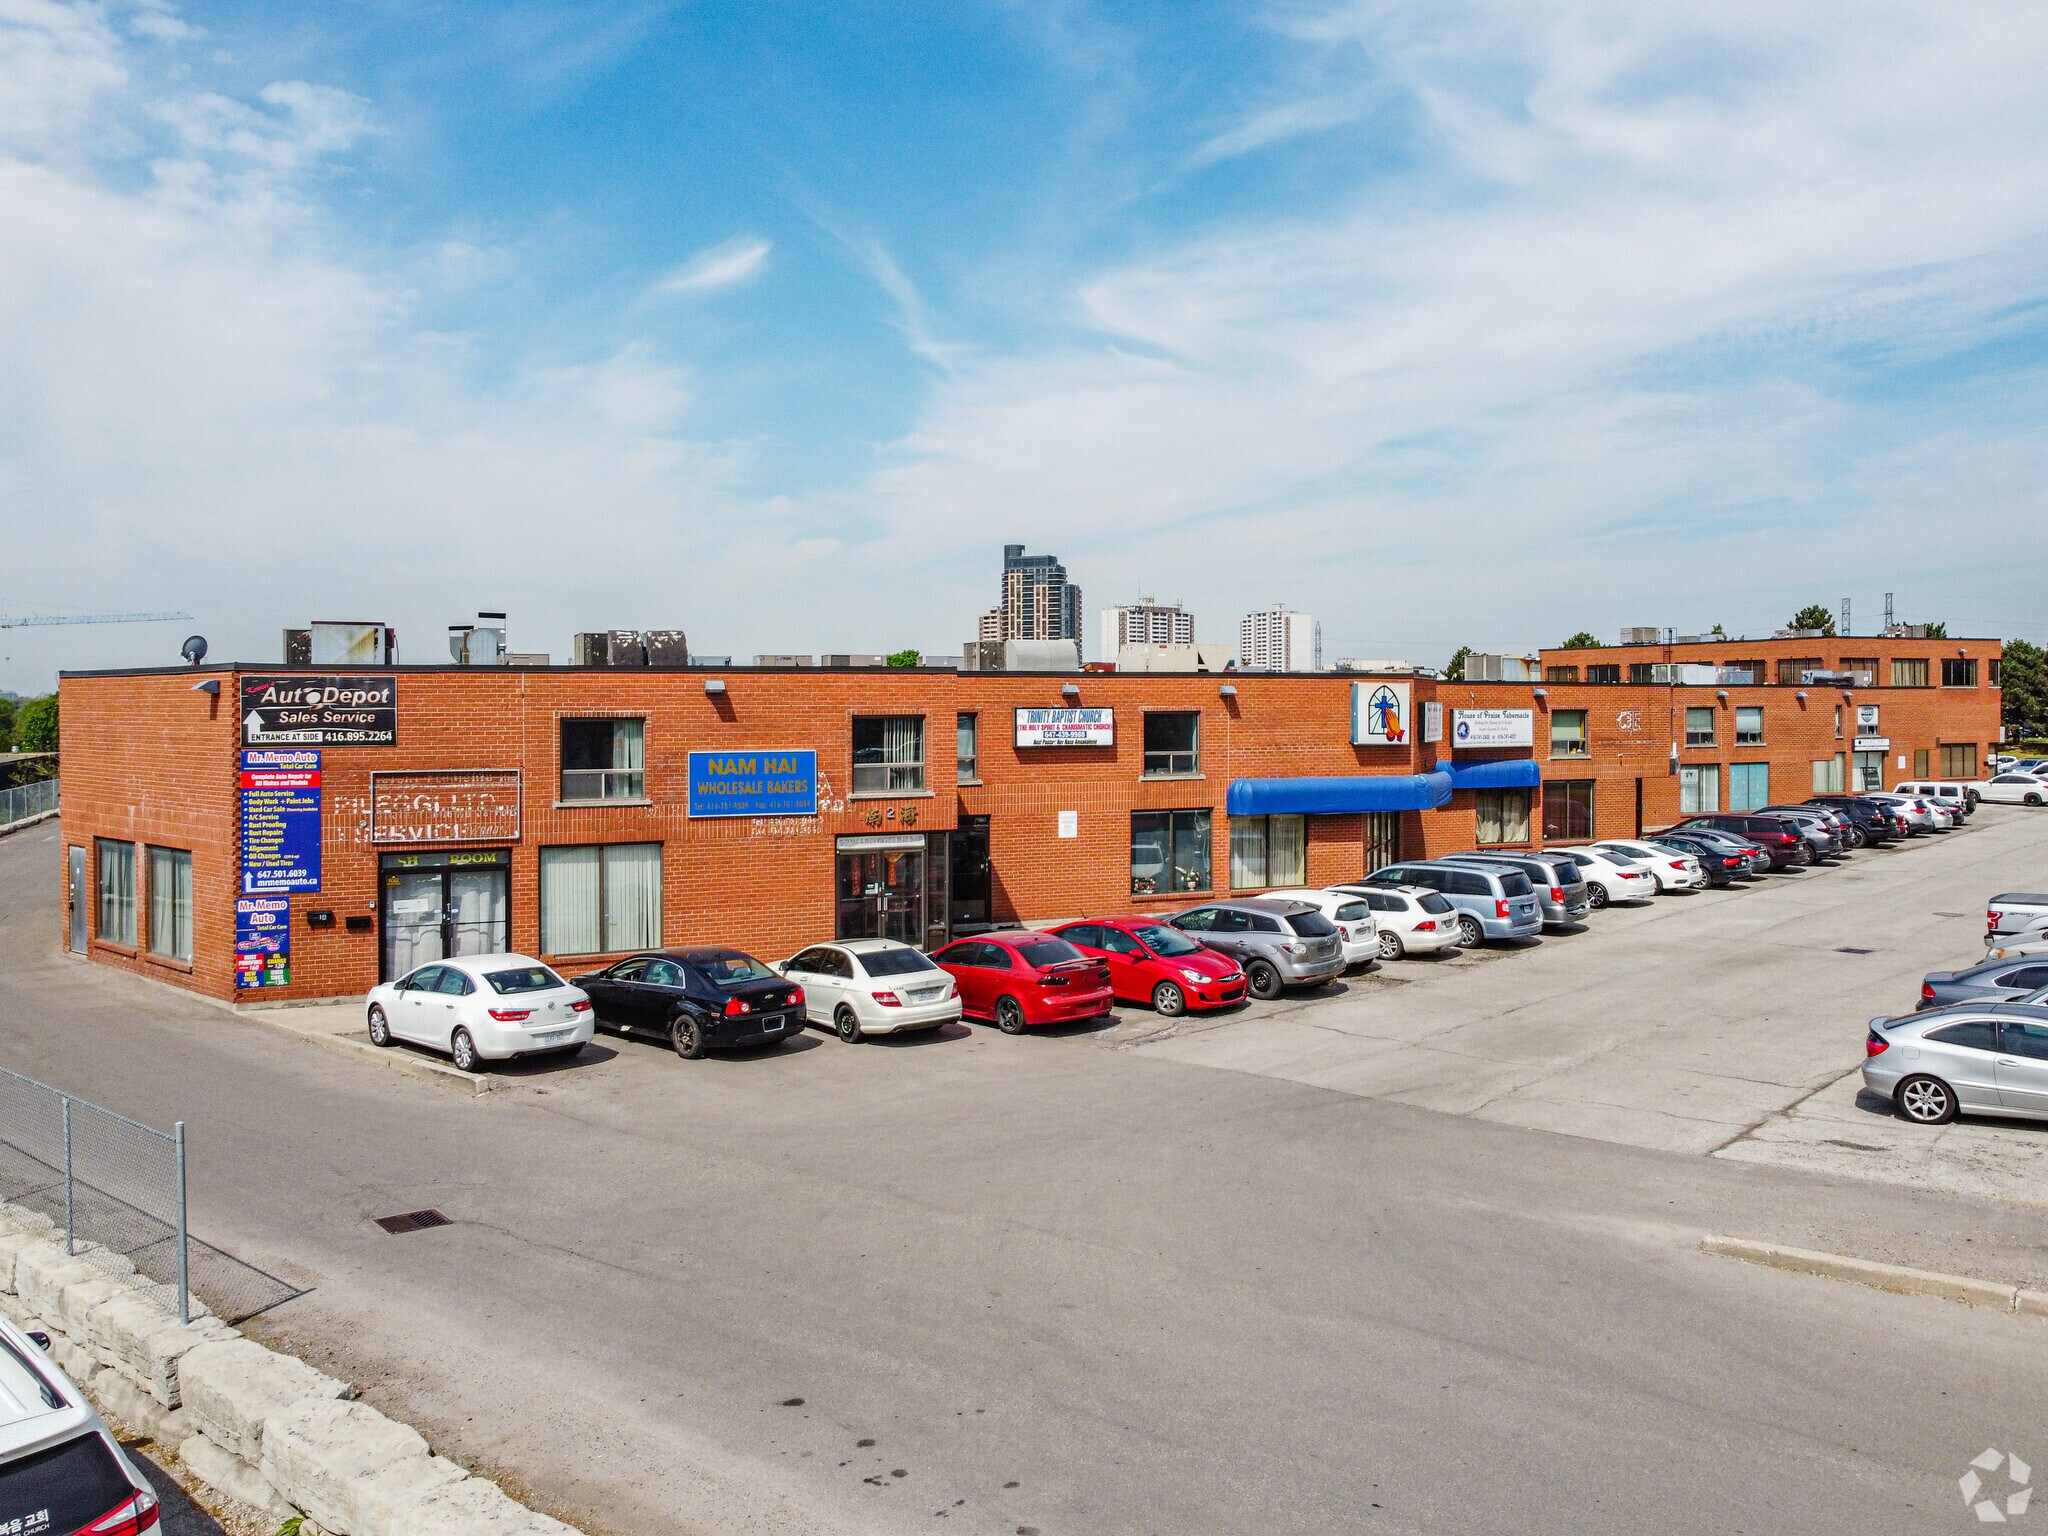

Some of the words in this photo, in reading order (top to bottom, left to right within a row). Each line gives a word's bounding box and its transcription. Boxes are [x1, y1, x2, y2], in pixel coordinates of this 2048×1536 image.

[279, 711, 318, 723] Sales
[323, 711, 375, 723] Service
[1027, 710, 1051, 723] TRINITY
[1052, 710, 1078, 723] BAPTIST
[1079, 710, 1103, 723] CHURCH
[251, 733, 290, 741] ENTRANCE
[292, 733, 301, 741] AT
[303, 732, 319, 741] SIDE
[325, 732, 393, 741] 416.895.2264
[248, 752, 264, 763] Mr.
[265, 752, 294, 763] Memo
[295, 752, 317, 762] Auto
[708, 758, 756, 775] NAM
[764, 758, 797, 774] HAI
[698, 781, 763, 795] WHOLESALE
[767, 780, 808, 793] BAKERS
[887, 807, 894, 819] 2
[450, 853, 496, 864] ROOM
[257, 870, 307, 878] 647.501.6039
[257, 878, 318, 887] mrmemoauto.ca
[238, 901, 255, 912] Mr.
[256, 900, 287, 911] Memo
[251, 913, 275, 924] Auto
[25, 1509, 49, 1527] 교회
[24, 1523, 50, 1536] CHURCH
